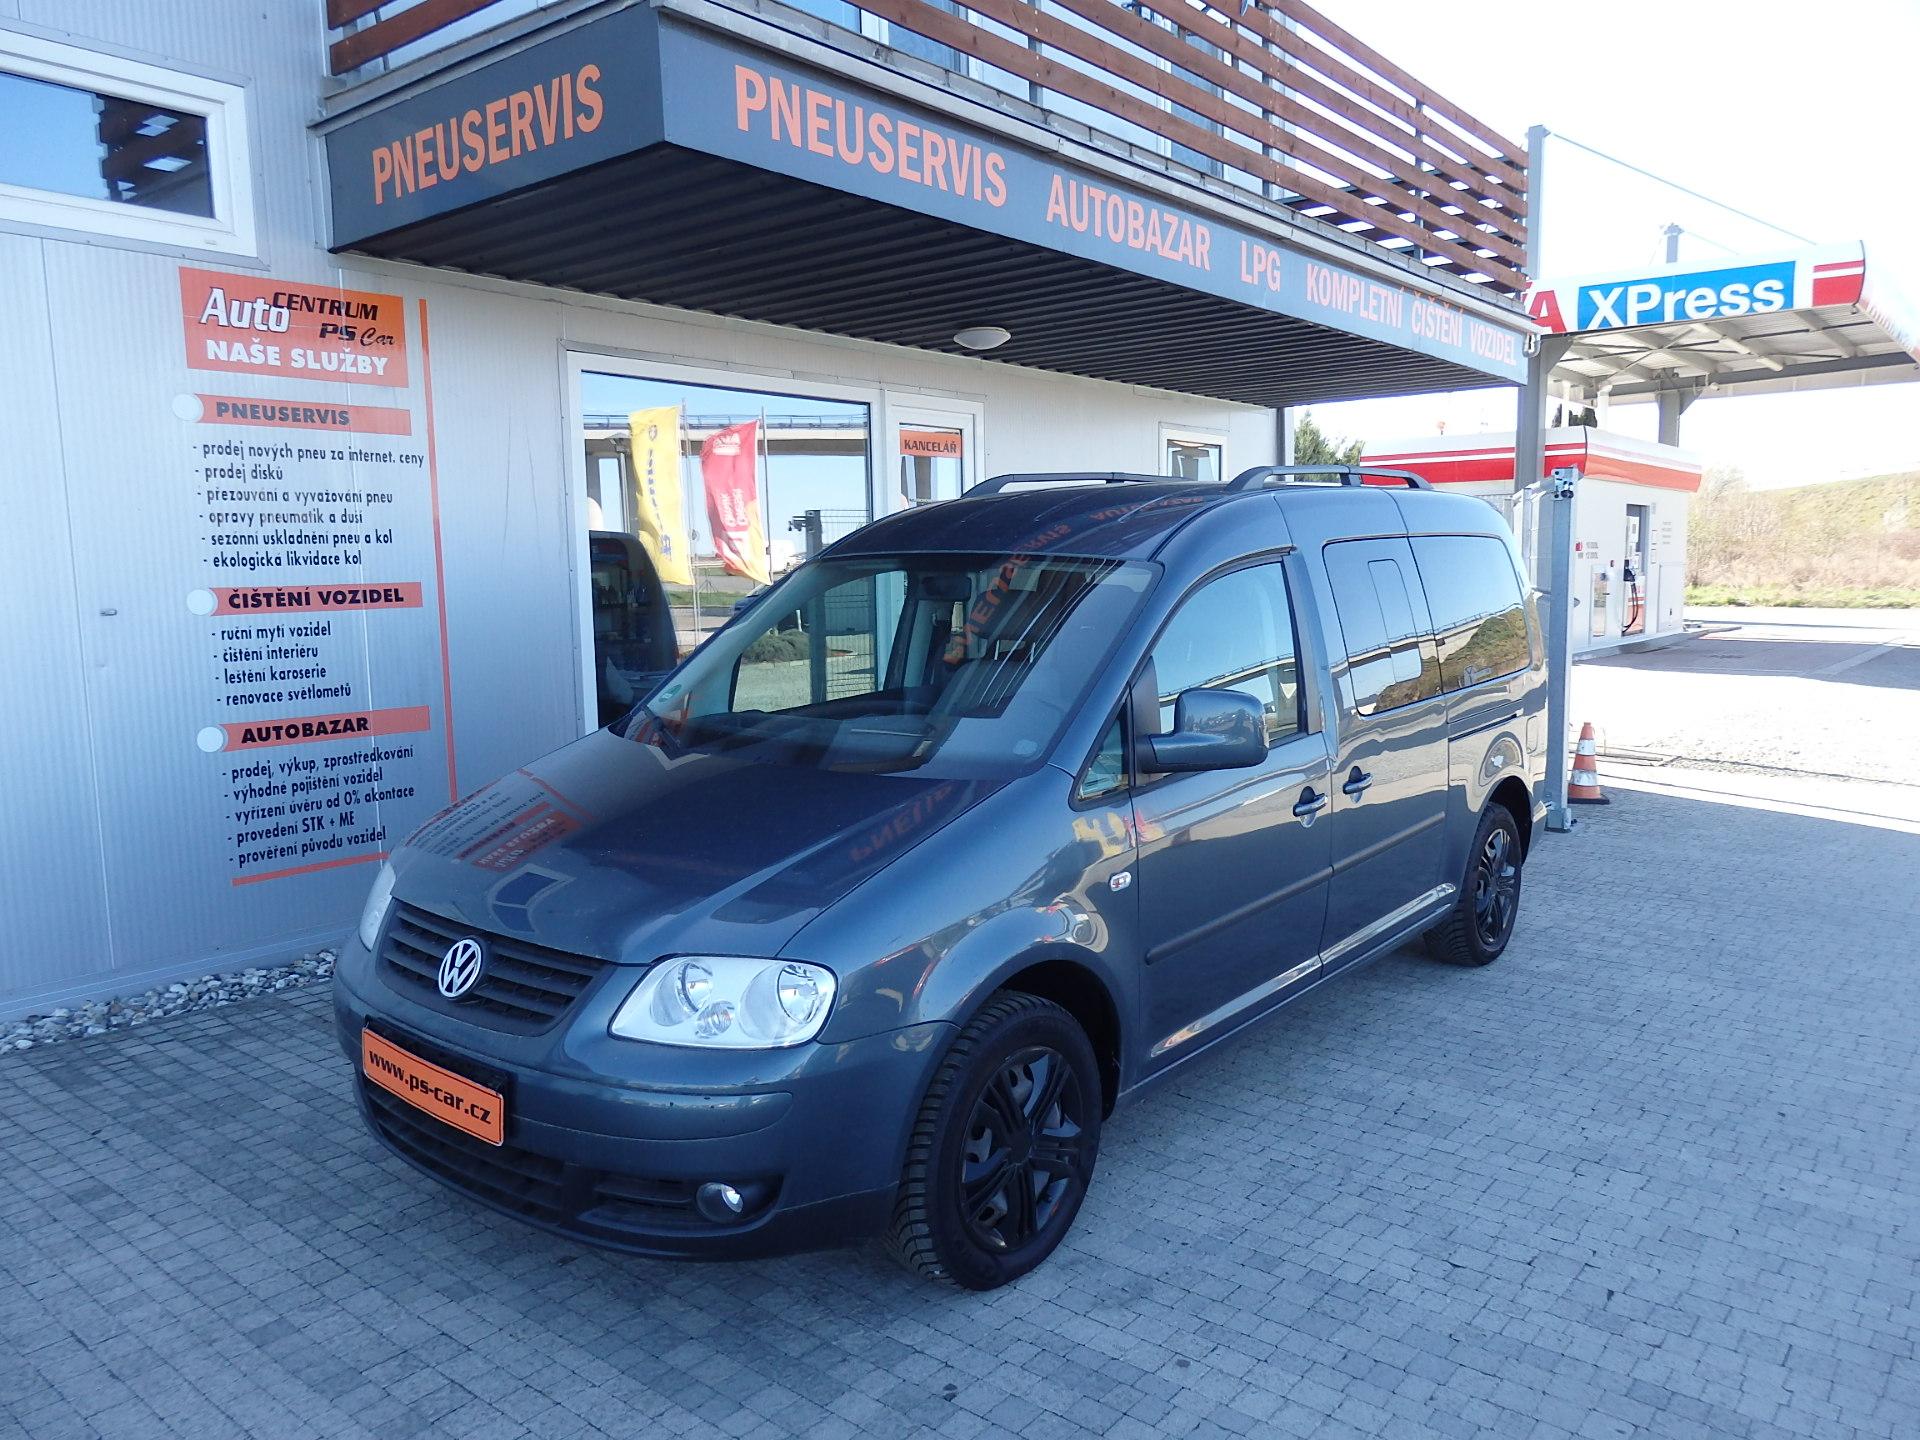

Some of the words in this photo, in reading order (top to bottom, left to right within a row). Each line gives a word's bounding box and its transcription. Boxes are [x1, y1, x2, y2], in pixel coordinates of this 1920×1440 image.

[372, 64, 604, 205] PNEUSERVIS
[734, 65, 1007, 207] PNEUSERVIS
[1046, 174, 1211, 271] AUTOBAZAR
[1240, 240, 1281, 292] LPG
[1307, 263, 1404, 329] KOMPLETNÍ
[1411, 291, 1464, 348] ČIŠTĚNÍ
[1469, 322, 1517, 366] VOZIDEL
[199, 287, 290, 333] Auto
[273, 292, 379, 321] CENTRUM
[1587, 279, 1785, 331] XPress
[319, 323, 357, 342] PS
[360, 328, 395, 346] Car
[207, 337, 281, 366] NAŠE
[291, 348, 388, 376] SLUŽBY
[216, 401, 350, 425] PNEUSERVIS
[203, 440, 244, 460] prodej
[249, 442, 293, 461] nových
[298, 448, 326, 462] pneu
[331, 450, 344, 460] za
[348, 446, 396, 463] internet.
[399, 453, 424, 468] ceny
[904, 439, 957, 453] KANCELÁŘ
[205, 462, 246, 483] prodej
[251, 463, 283, 480] disků
[207, 486, 278, 505] přezouvání
[282, 491, 289, 501] a
[294, 489, 362, 506] vyvažování
[366, 492, 393, 506] pneu
[209, 512, 254, 527] opravy
[260, 508, 324, 527] pneumatik
[329, 513, 336, 523] a
[263, 529, 329, 544] uskladnění
[333, 534, 360, 547] pneu
[364, 534, 371, 544] a
[375, 529, 392, 544] kol
[213, 551, 282, 571] ekologická
[287, 550, 340, 566] likvidace
[344, 549, 362, 565] kol
[228, 586, 311, 609] ČIŠTĚNÍ
[317, 588, 405, 605] VOZIDEL
[221, 624, 252, 640] ruční
[289, 621, 331, 637] vozidel
[222, 646, 263, 662] čištění
[267, 643, 318, 660] interiéru
[224, 668, 266, 684] leštění
[270, 663, 327, 681] karoserie
[226, 690, 283, 706] renovace
[288, 682, 352, 701] světlometů
[241, 716, 370, 744] AUTOBAZAR
[231, 760, 275, 783] prodej,
[323, 745, 414, 771] zprostředkování
[233, 781, 287, 804] výhodné
[343, 767, 383, 786] vozidel
[235, 801, 285, 825] vyřízení
[326, 792, 340, 808] od
[344, 789, 361, 805] 0%
[364, 787, 414, 803] akontace
[237, 821, 298, 847] provedení
[302, 816, 325, 833] STK
[339, 811, 354, 827] ME
[239, 841, 297, 868] prověření
[302, 834, 343, 857] původu
[347, 826, 386, 845] vozidel
[369, 1050, 492, 1125] www.ps-car.cz
